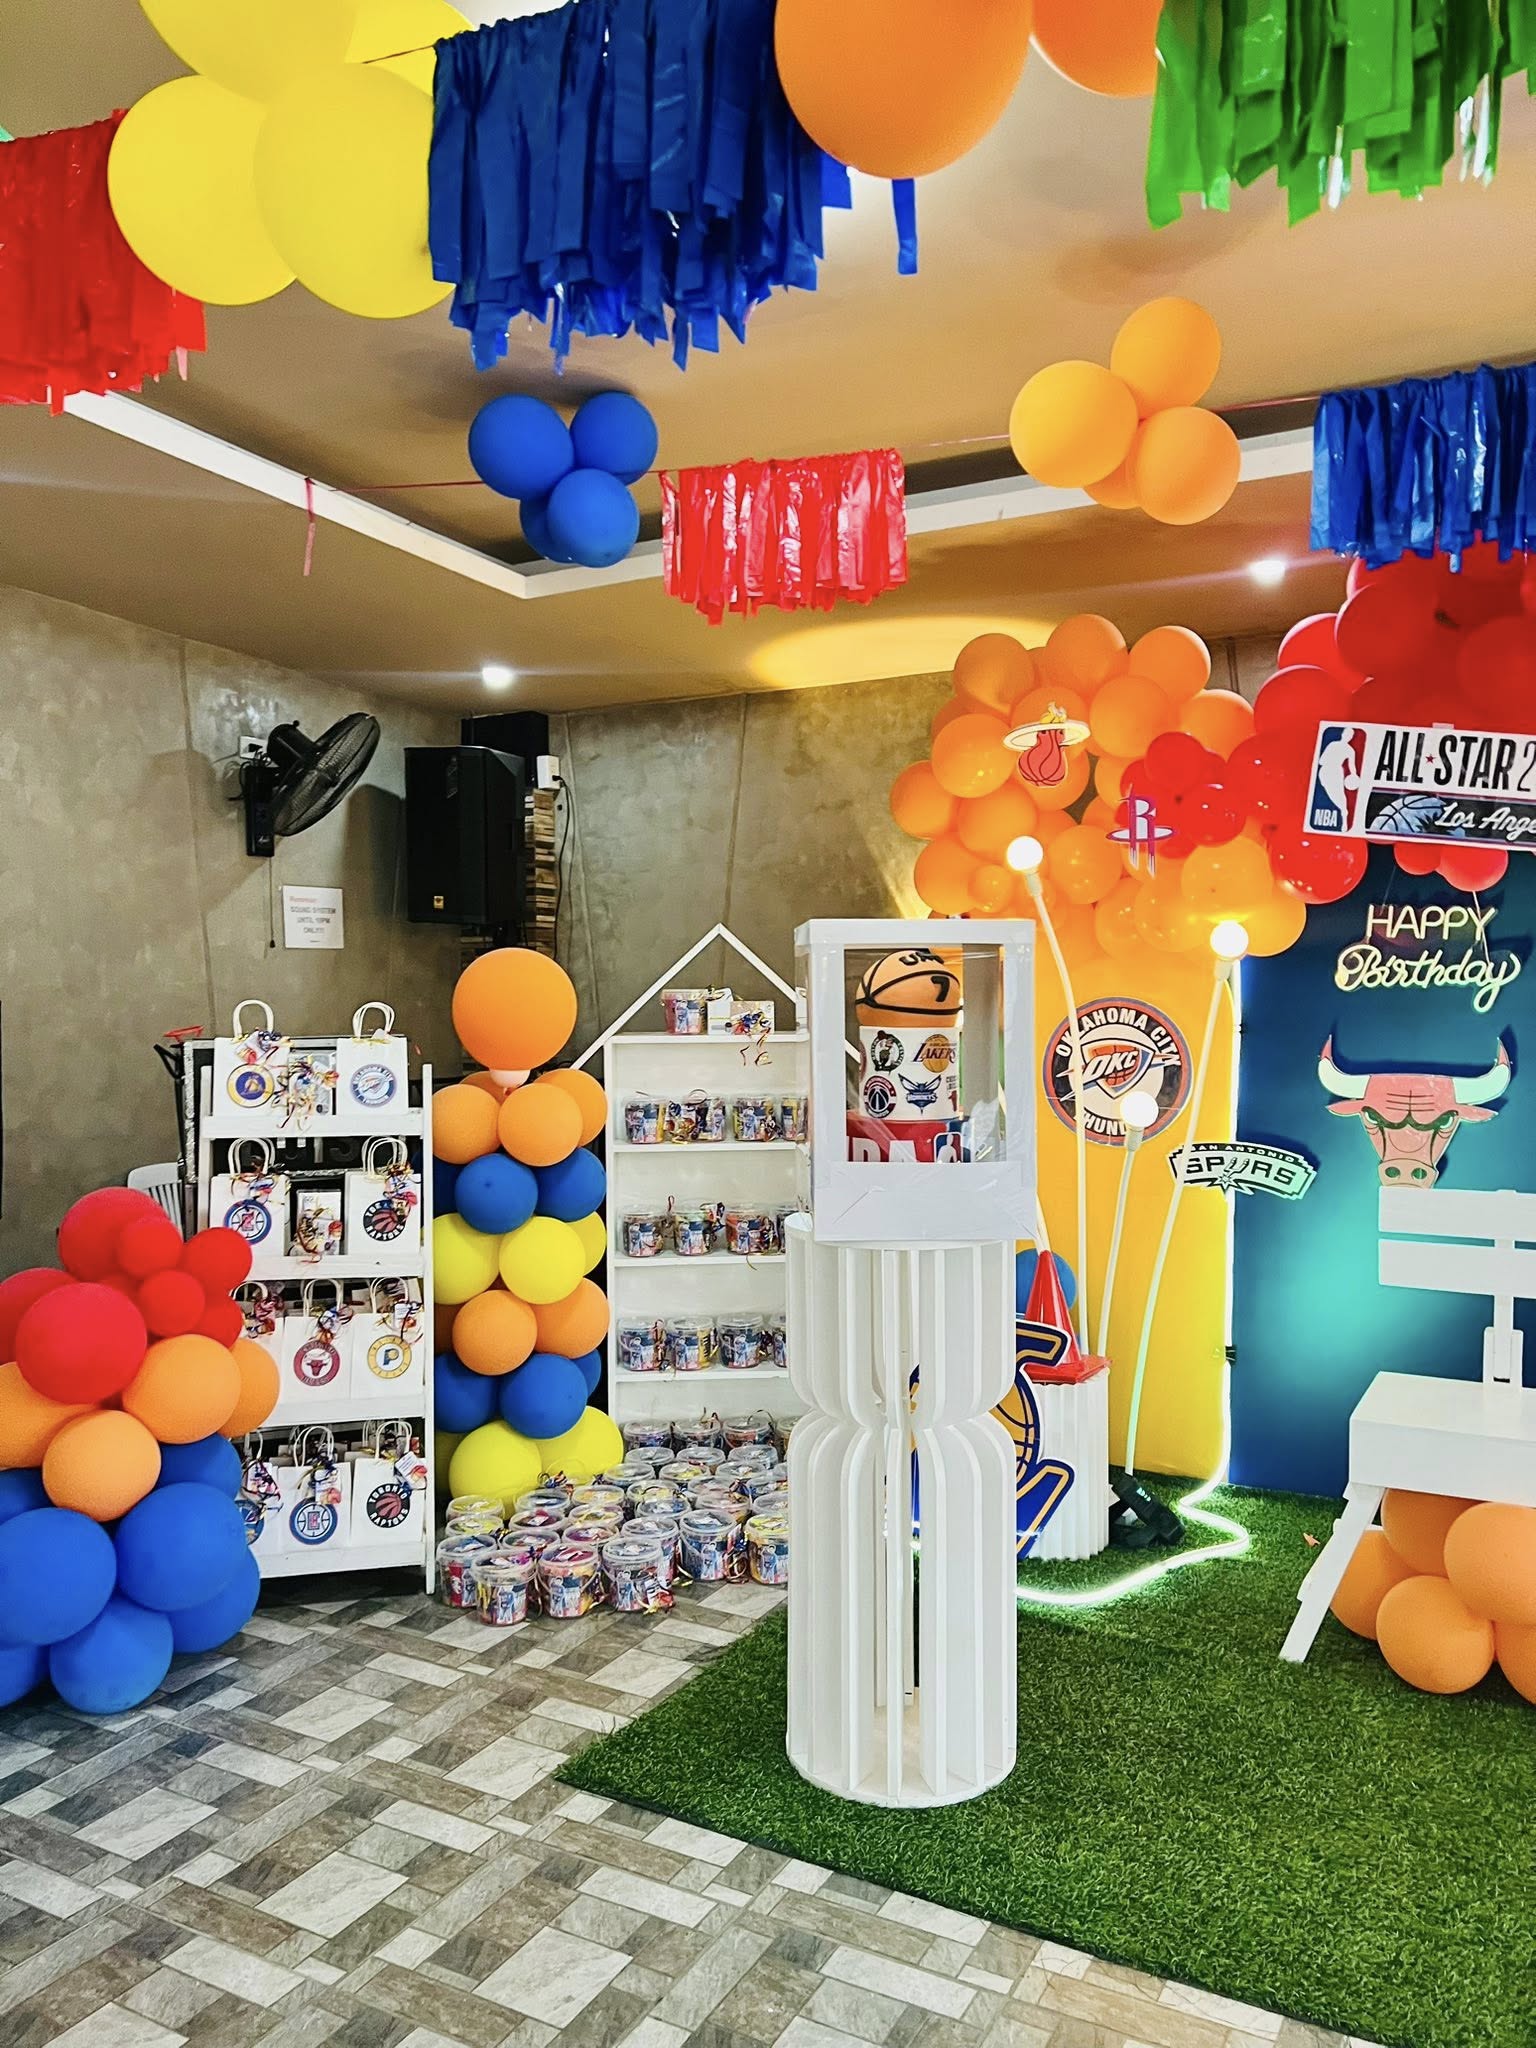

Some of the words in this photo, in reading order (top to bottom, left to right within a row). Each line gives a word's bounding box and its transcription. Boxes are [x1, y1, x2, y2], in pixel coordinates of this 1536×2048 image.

[1374, 730, 1425, 784] ALL
[1434, 734, 1517, 792] STAR
[1312, 808, 1339, 829] NBA
[1434, 801, 1475, 828] Los
[1366, 904, 1497, 941] HAPPY
[930, 975, 951, 1003] 7
[1335, 944, 1522, 1013] Birthday
[1055, 1007, 1150, 1058] OKAHOMA
[1149, 1026, 1182, 1067] CITY
[1081, 1050, 1140, 1081] OKC
[1224, 1145, 1296, 1164] ANTONIO
[1186, 1156, 1297, 1186] SPURS
[368, 1484, 408, 1504] TORONTO
[369, 1508, 409, 1527] RAPTORS
